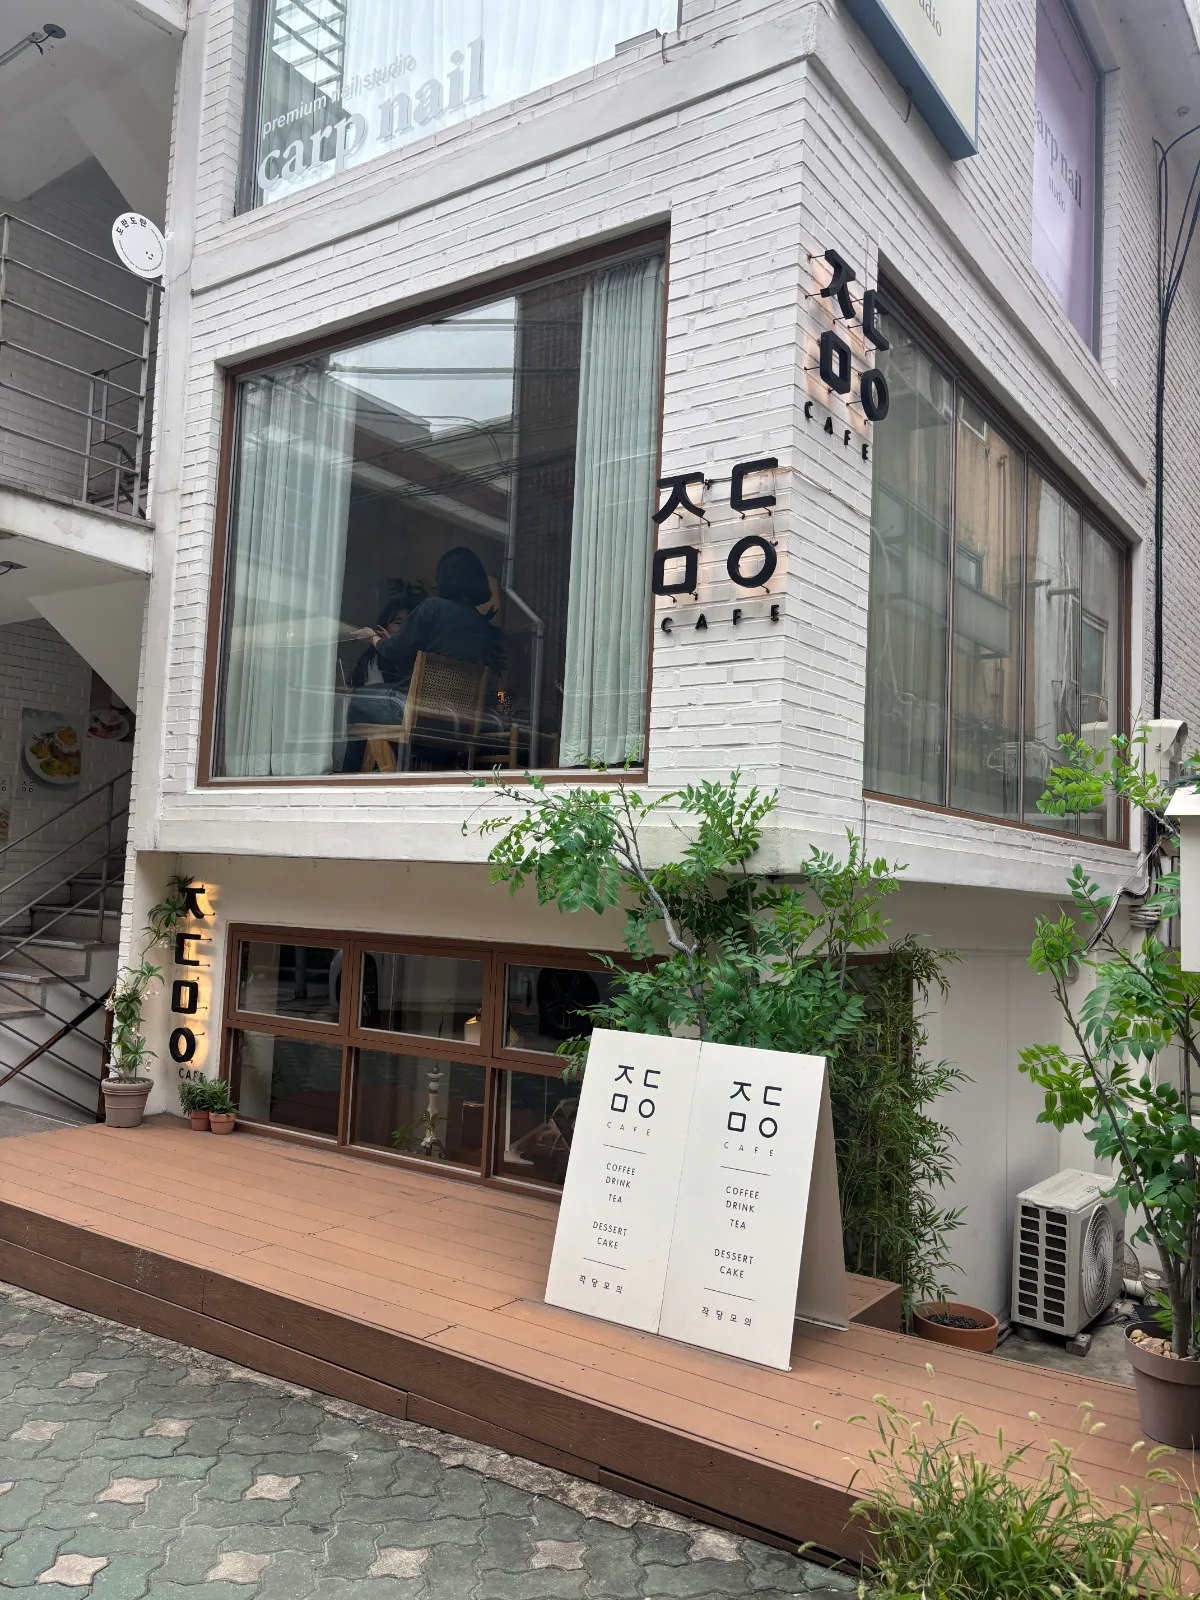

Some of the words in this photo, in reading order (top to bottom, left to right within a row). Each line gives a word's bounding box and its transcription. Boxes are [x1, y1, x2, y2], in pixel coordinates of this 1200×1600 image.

[262, 94, 327, 140] premium
[331, 75, 361, 103] nail
[363, 53, 416, 90] studio
[258, 112, 367, 190] carp
[376, 36, 487, 142] nail
[1034, 101, 1058, 171] arp
[1060, 151, 1082, 210] nail
[1048, 175, 1066, 213] studio
[115, 216, 147, 236] 도란도란
[804, 400, 870, 461] CAFE
[660, 604, 780, 633] CAFE
[606, 1121, 651, 1137] CAFE
[723, 1141, 774, 1157] CAFE
[606, 1162, 636, 1176] COFFEE
[605, 1175, 631, 1189] DRINK
[608, 1193, 623, 1204] TEA
[725, 1185, 760, 1200] COFFEE
[725, 1200, 755, 1213] DRINK
[592, 1220, 628, 1237] DESSERT
[729, 1218, 746, 1230] TEA
[596, 1237, 619, 1250] CAKE
[714, 1248, 754, 1265] DESSERT
[719, 1265, 745, 1279] CAKE
